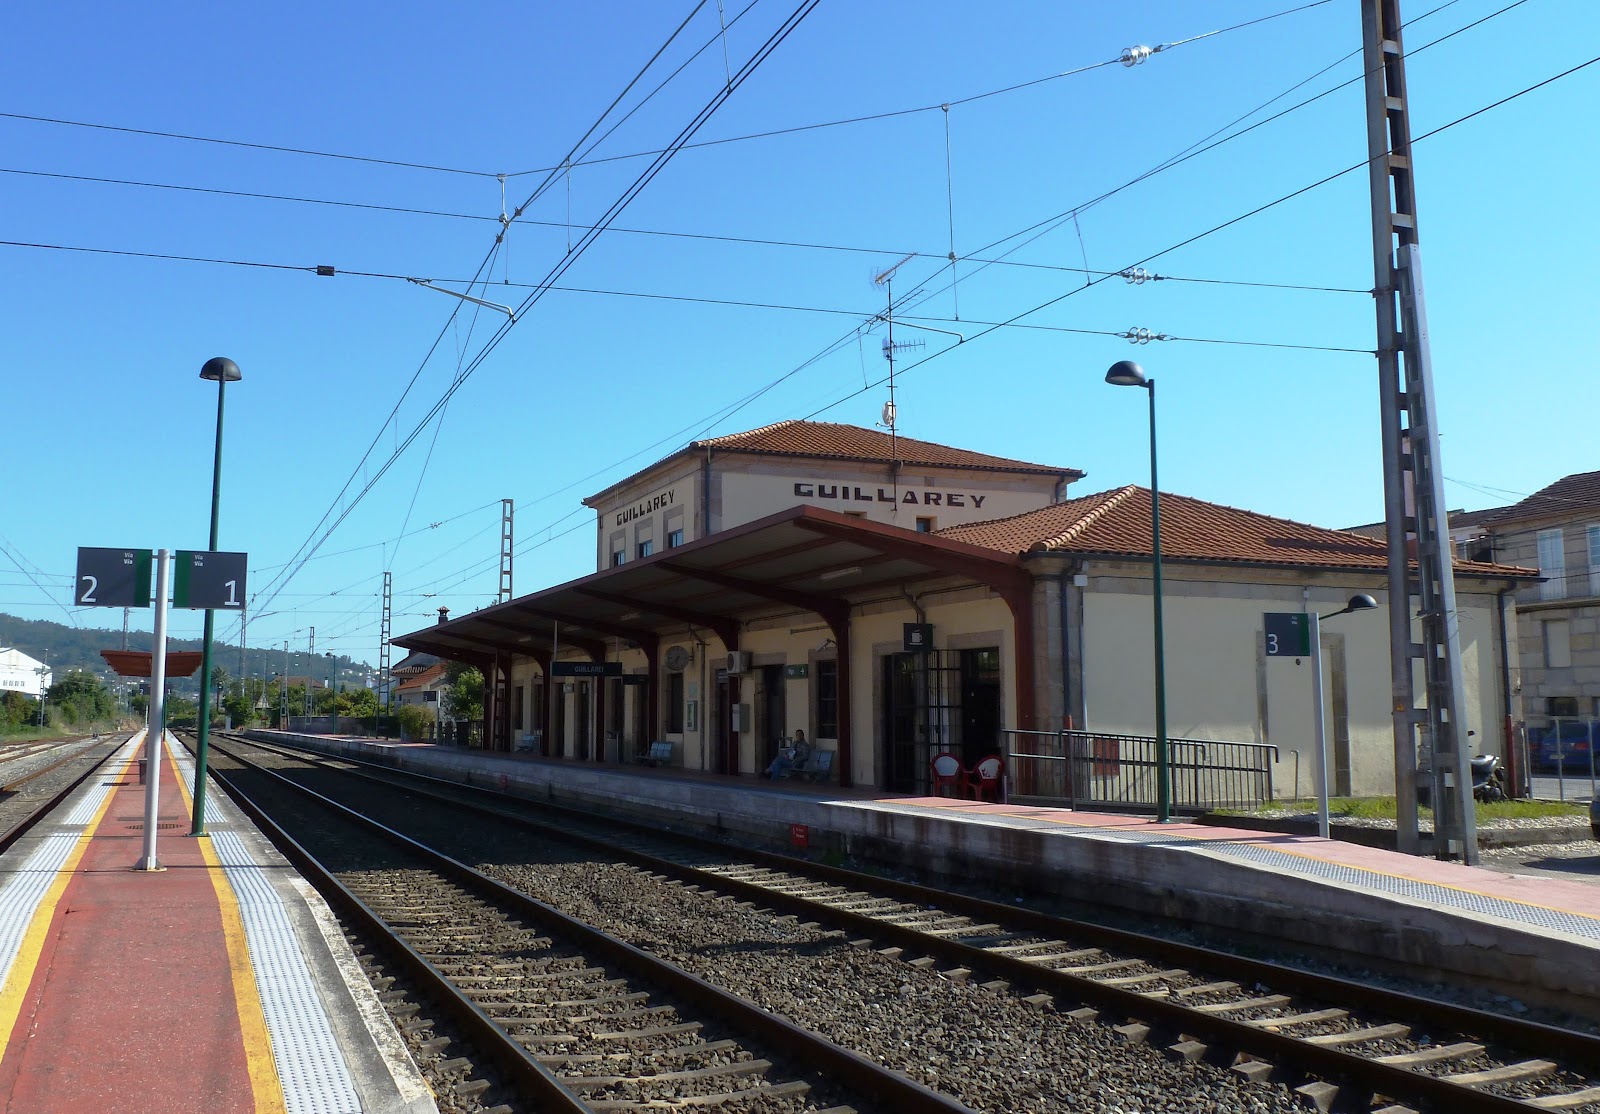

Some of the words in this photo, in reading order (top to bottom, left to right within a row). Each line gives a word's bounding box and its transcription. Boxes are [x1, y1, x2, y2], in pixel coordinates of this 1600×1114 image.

[616, 489, 675, 526] GUILLAREY
[794, 483, 986, 509] GUILLAREY
[80, 575, 98, 603] 2
[224, 580, 241, 606] 1
[1267, 633, 1279, 654] 3
